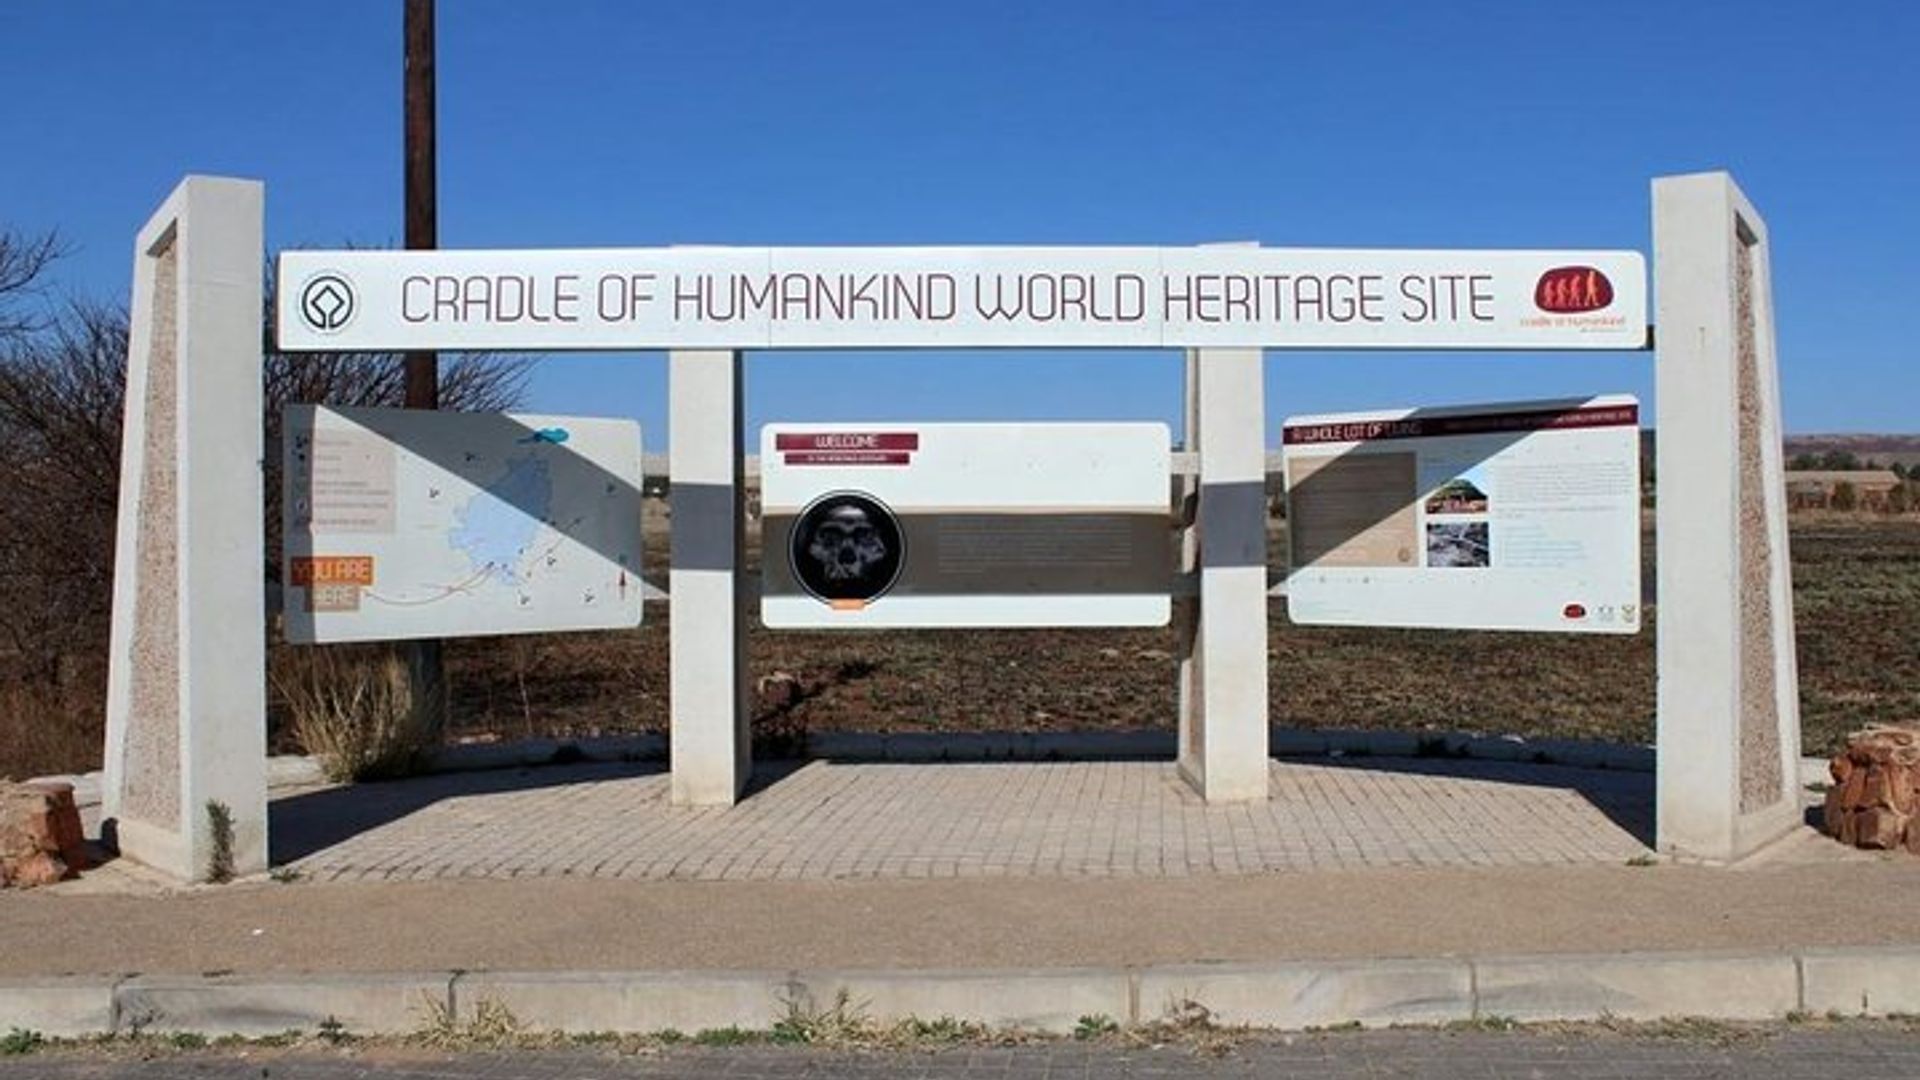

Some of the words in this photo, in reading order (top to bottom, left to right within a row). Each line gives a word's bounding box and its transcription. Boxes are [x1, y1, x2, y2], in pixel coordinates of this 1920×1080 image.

[402, 275, 578, 322] CRADLE
[597, 274, 655, 322] OF
[674, 273, 955, 321] HUMANKIND
[975, 273, 1144, 321] WORLD
[1163, 274, 1384, 322] HERITAGE
[1399, 275, 1494, 322] SITE
[1344, 424, 1364, 439] LOT
[1367, 422, 1383, 437] OF
[815, 435, 879, 448] WELCOME
[293, 559, 331, 580] YOU
[335, 558, 370, 580] ARE
